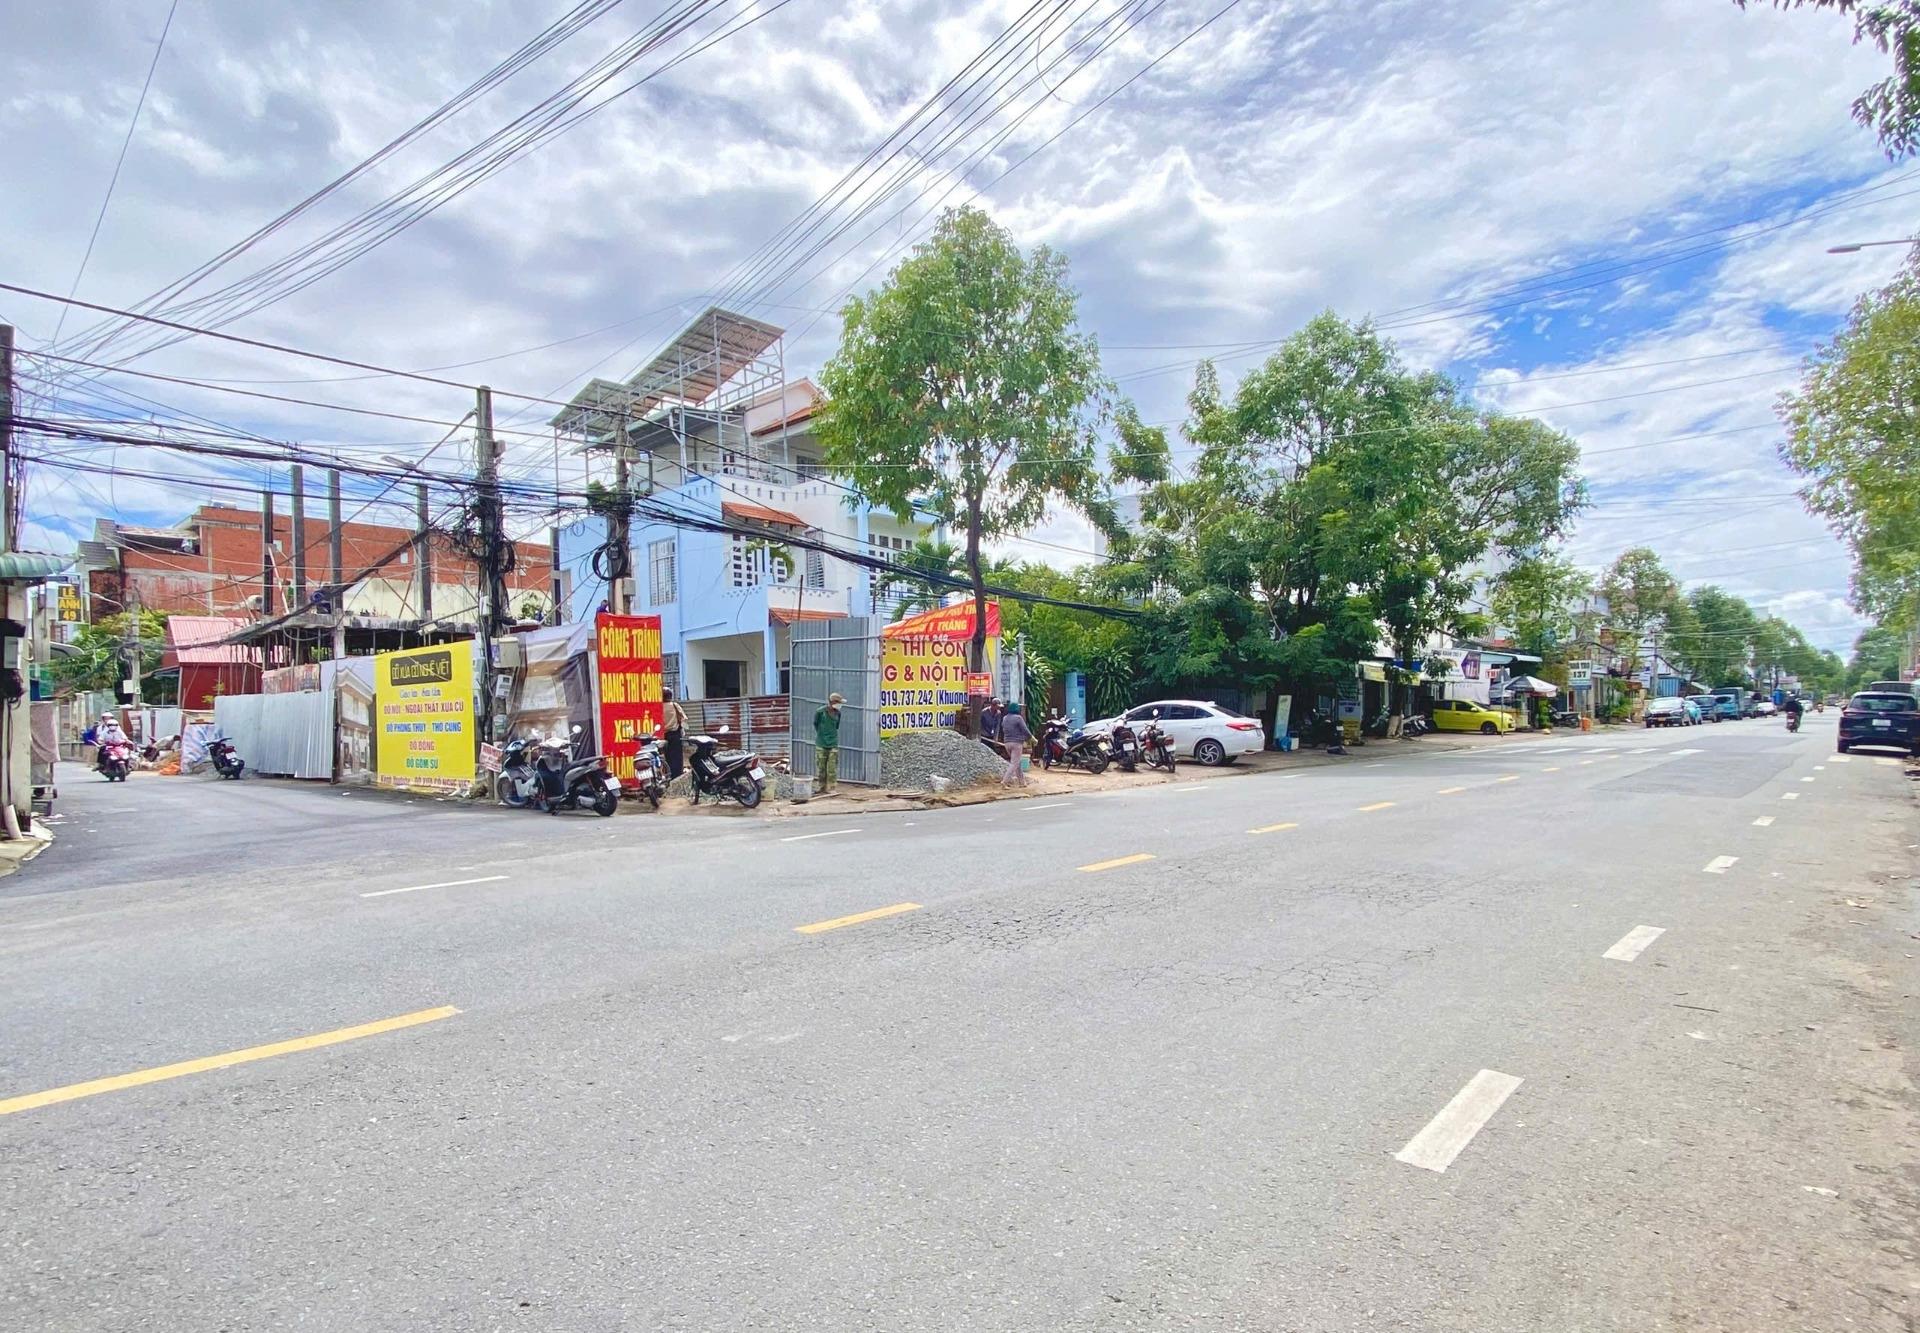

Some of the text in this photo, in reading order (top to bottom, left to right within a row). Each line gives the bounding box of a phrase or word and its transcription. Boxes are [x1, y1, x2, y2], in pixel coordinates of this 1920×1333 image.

[59, 598, 80, 609] ANH
[601, 620, 661, 658] CÔNG TRÌNH
[902, 640, 926, 656] THI
[903, 664, 914, 681] &
[920, 661, 947, 686] NỘI
[626, 672, 640, 703] THI
[641, 666, 663, 703] CÔNG
[881, 690, 933, 706] 919.737.242
[881, 712, 933, 729] 939.179.622
[614, 719, 635, 743] XIN
